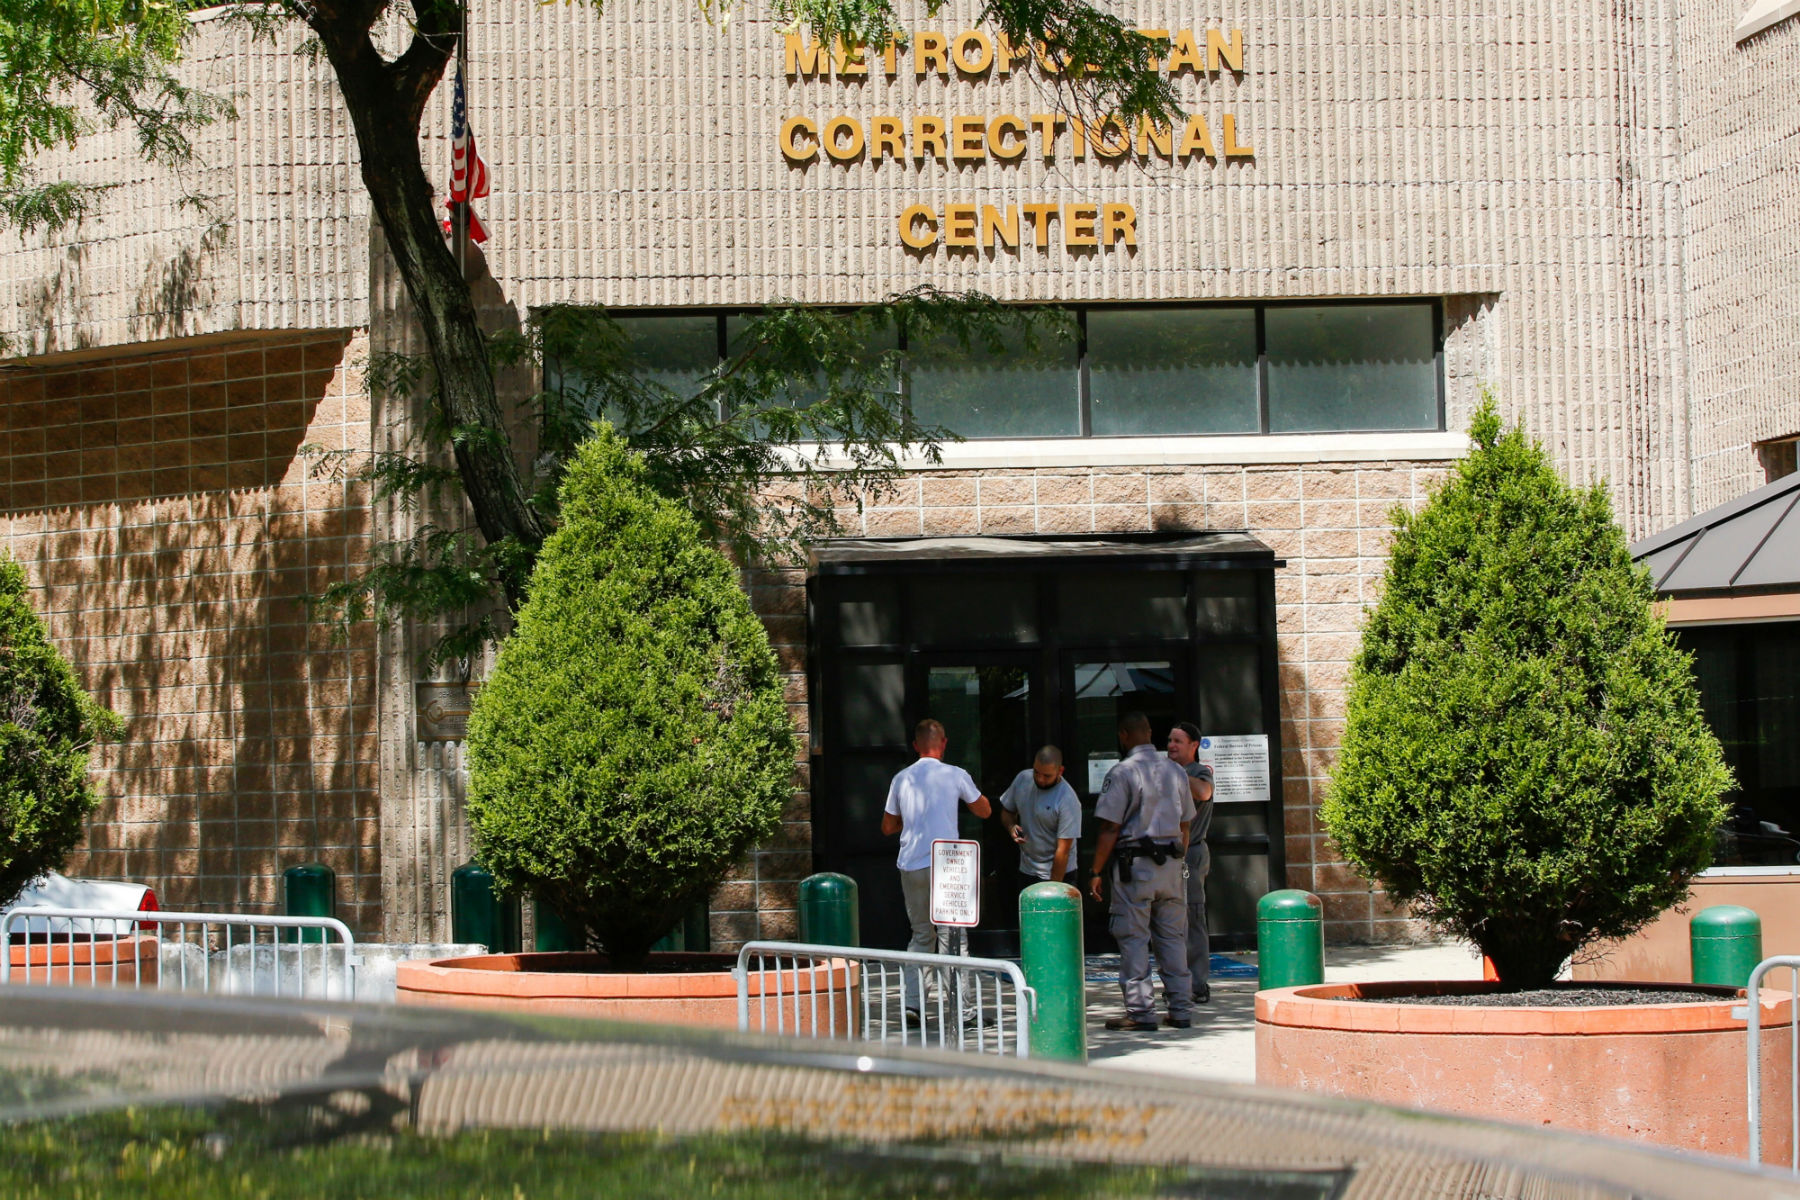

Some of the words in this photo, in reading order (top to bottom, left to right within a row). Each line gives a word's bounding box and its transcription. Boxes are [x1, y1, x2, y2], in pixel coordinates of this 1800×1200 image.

[779, 113, 1254, 160] CORRECTIONAL
[899, 202, 1137, 248] CENTER
[938, 849, 973, 857] GOVERNMENT
[944, 891, 966, 899] SERVICE
